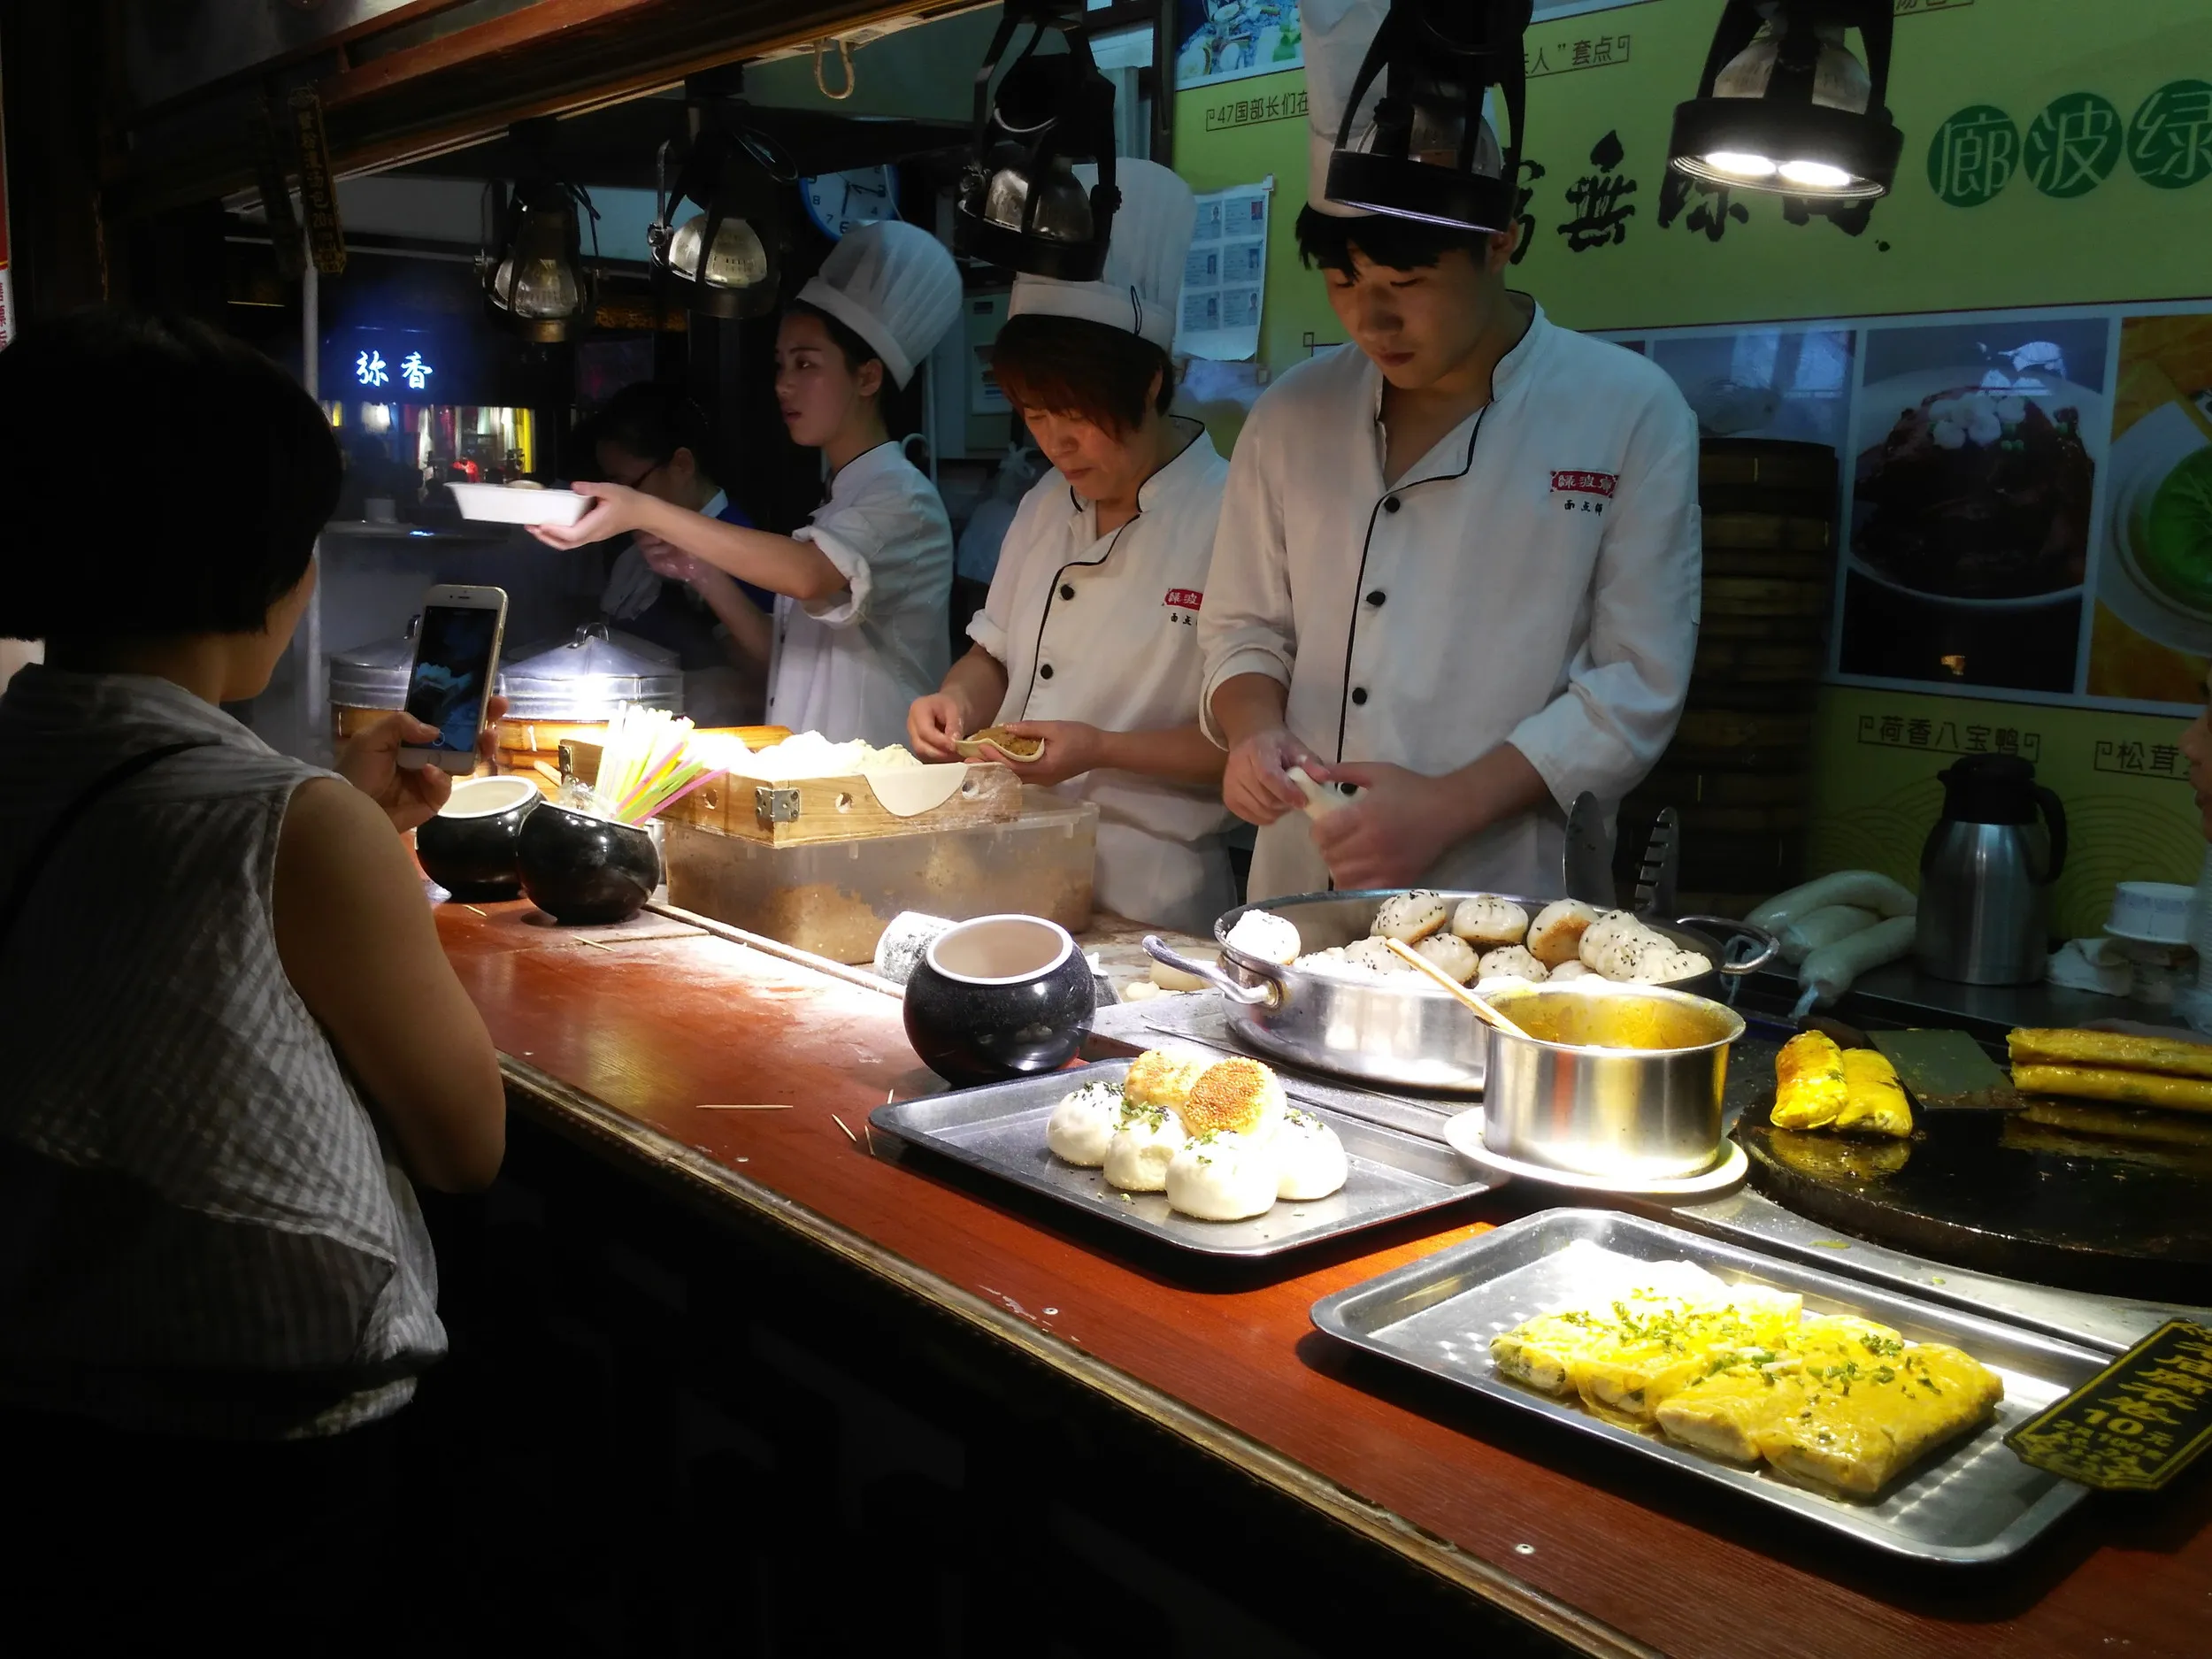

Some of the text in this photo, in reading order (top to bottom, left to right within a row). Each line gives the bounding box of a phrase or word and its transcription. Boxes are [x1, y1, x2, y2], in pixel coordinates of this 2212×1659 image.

[1523, 35, 1613, 74] 人”套点
[356, 350, 434, 389] 弥香
[1879, 715, 2019, 755] 荷香八宝鸭
[2116, 741, 2190, 777] 松茸
